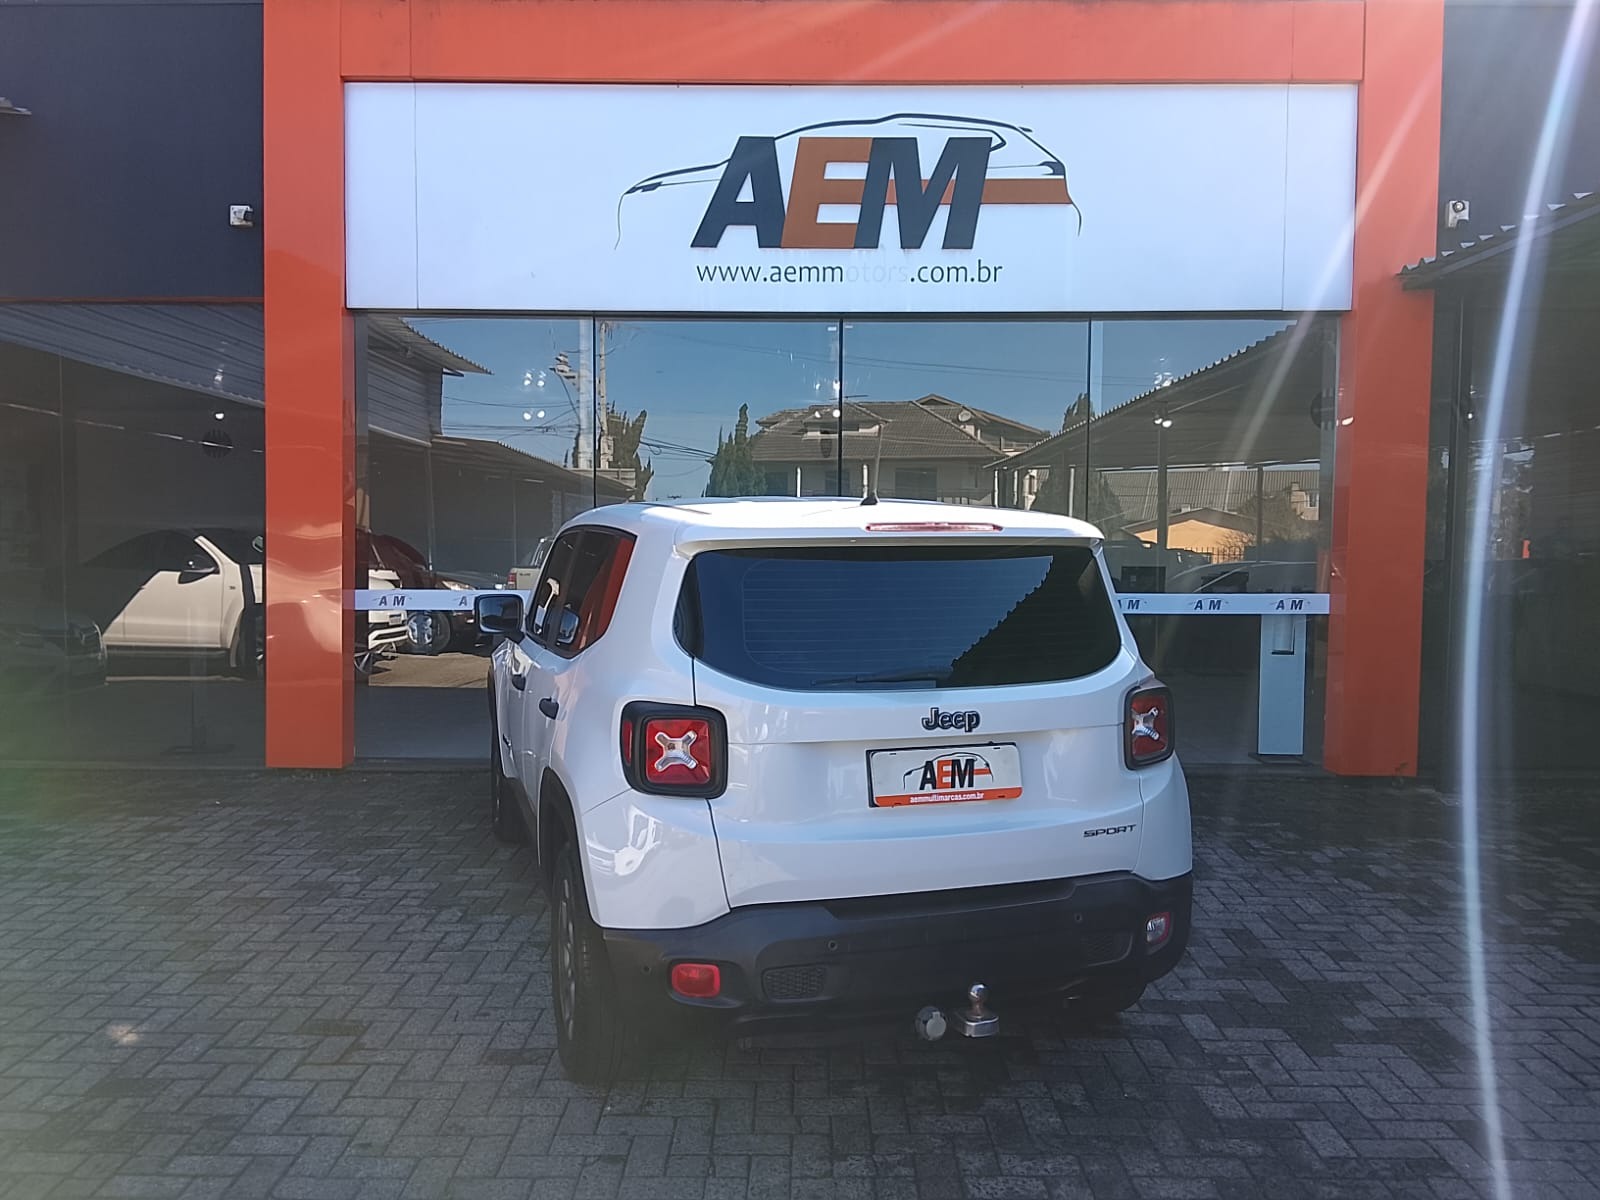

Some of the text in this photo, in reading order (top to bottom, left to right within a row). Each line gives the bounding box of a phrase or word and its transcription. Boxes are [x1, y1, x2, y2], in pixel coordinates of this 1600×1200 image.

[690, 136, 992, 249] AEM
[921, 707, 981, 732] Jeep
[919, 758, 975, 790] AEM
[1083, 824, 1137, 837] SPORT
